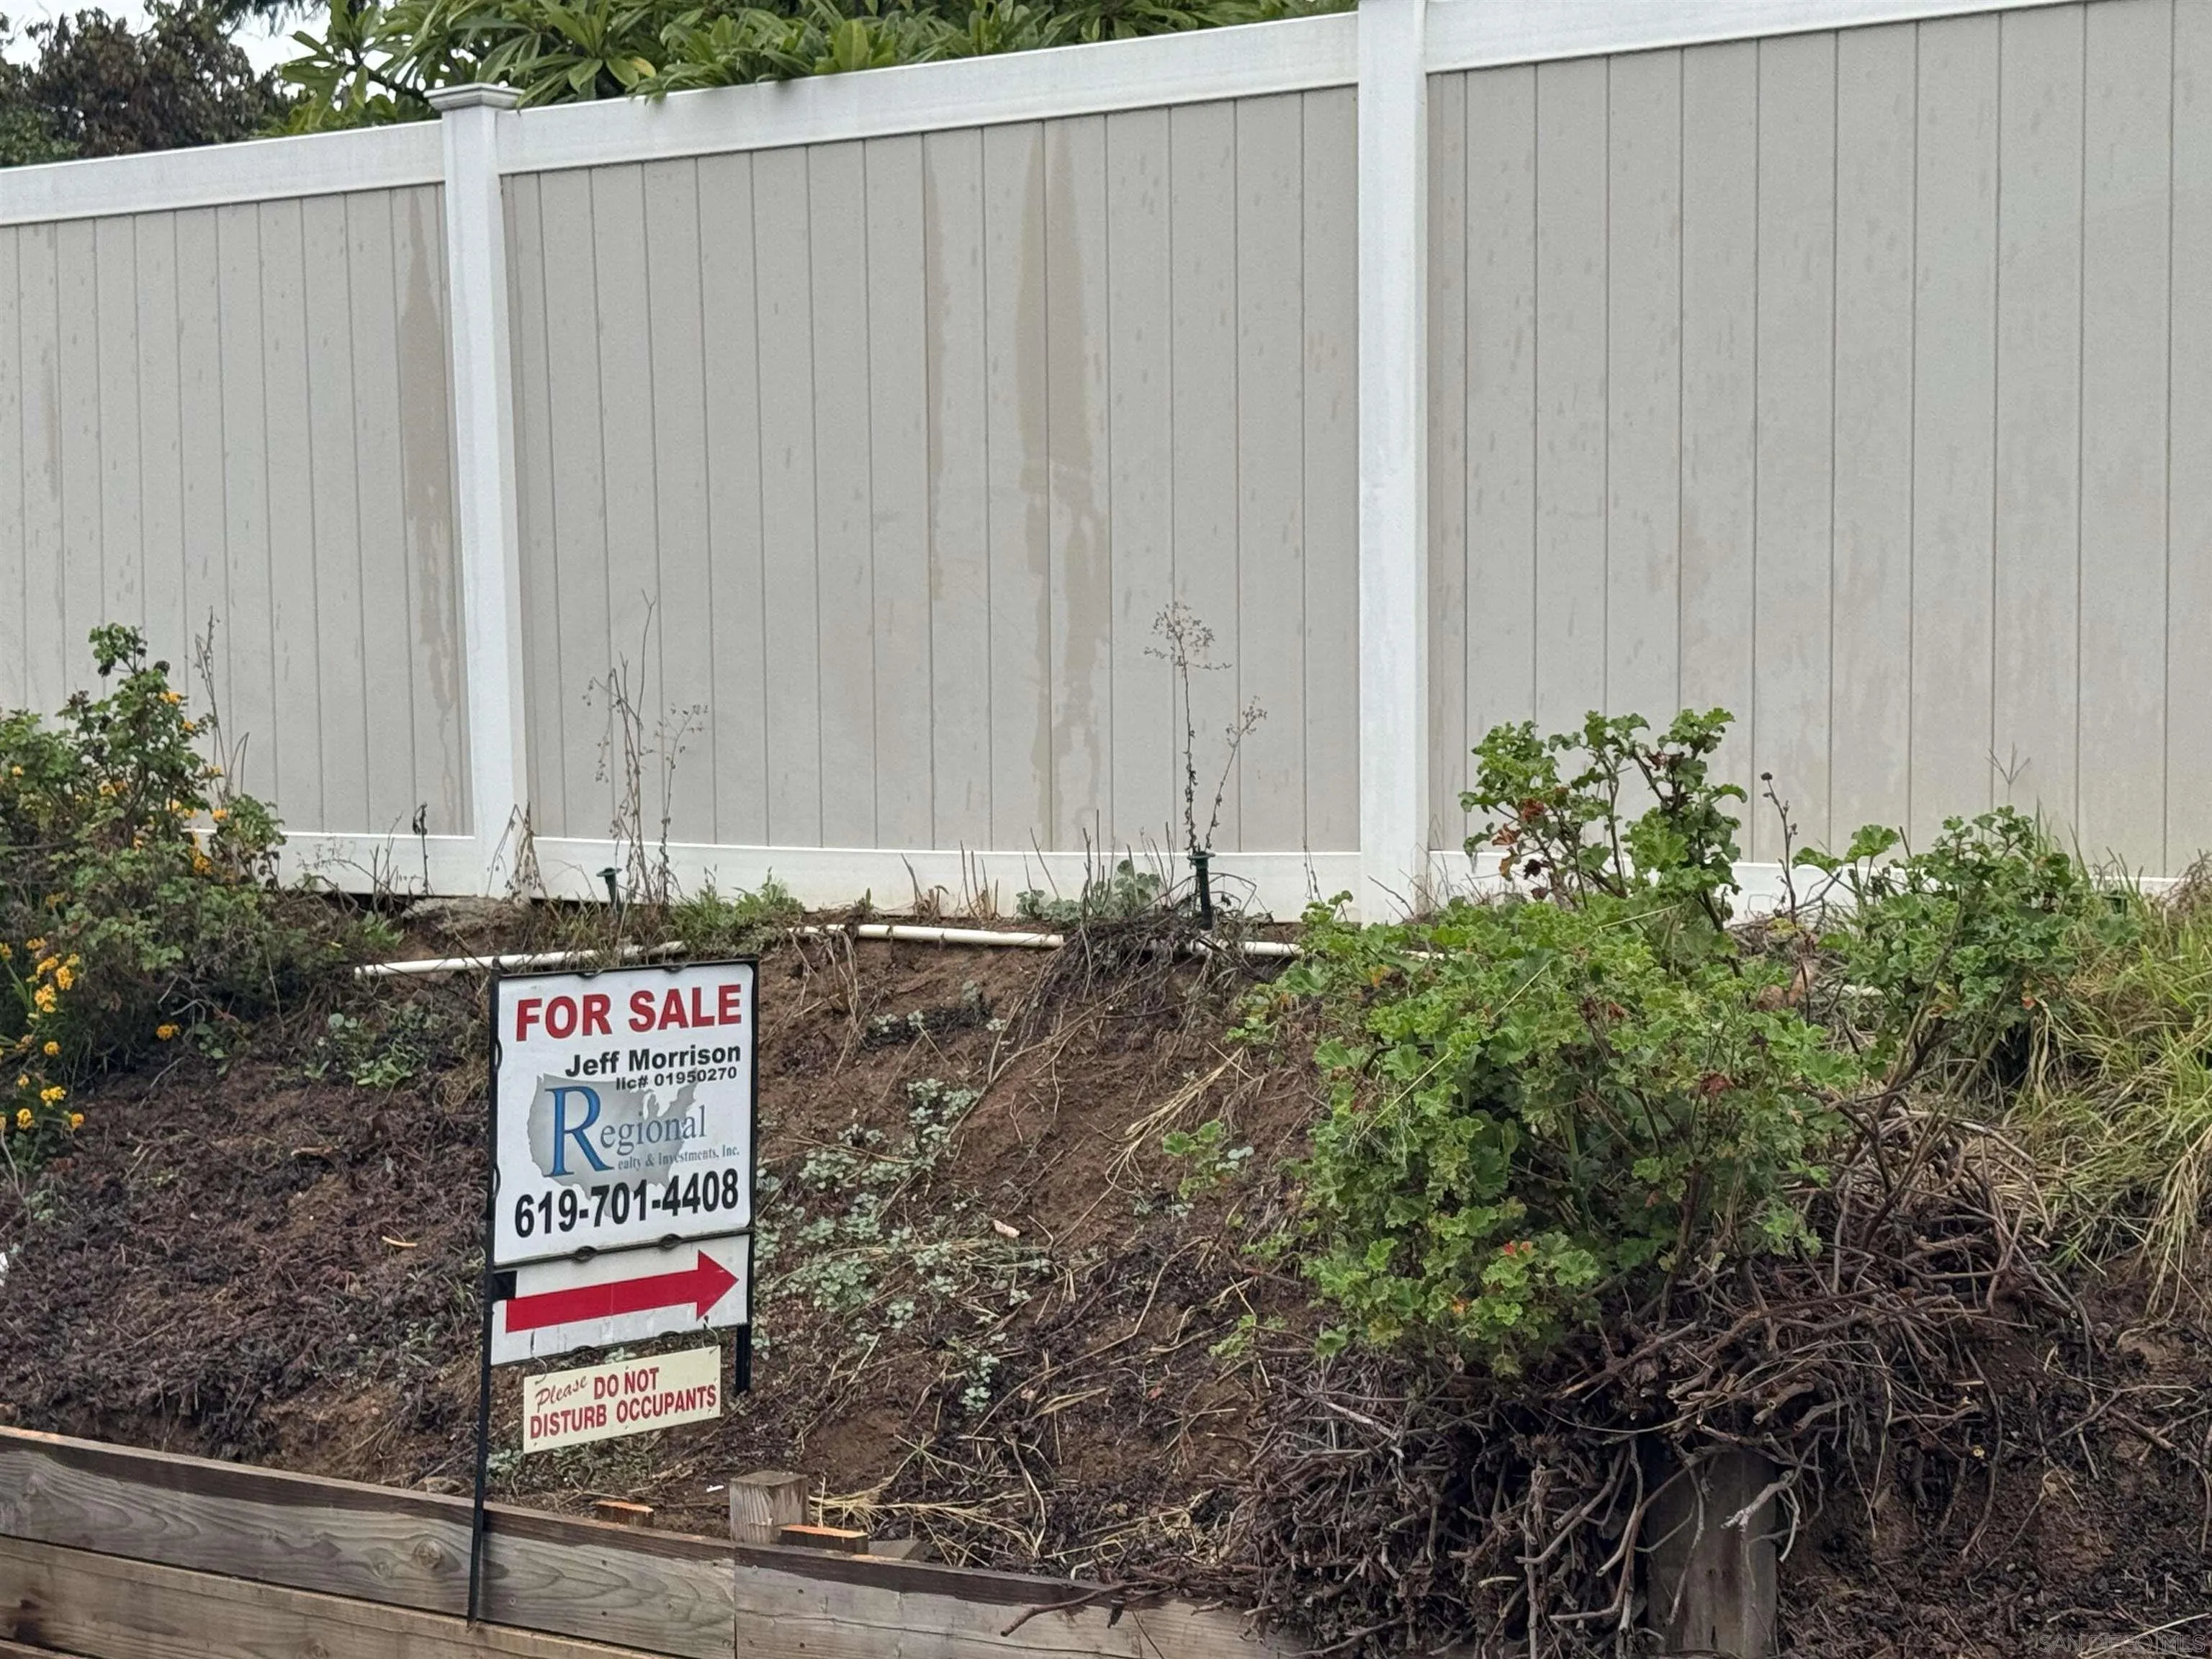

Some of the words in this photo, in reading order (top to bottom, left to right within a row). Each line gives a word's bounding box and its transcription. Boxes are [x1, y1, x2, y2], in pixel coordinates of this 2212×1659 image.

[516, 994, 613, 1042] FOR
[628, 984, 742, 1033] SALE
[565, 1051, 620, 1077] Jeff
[629, 1044, 741, 1071] Morrison
[655, 1066, 737, 1087] 01950270
[544, 1085, 706, 1178] Regional
[645, 1154, 655, 1167] &
[722, 1144, 740, 1157] Inc.
[514, 1168, 739, 1238] 619-701-4408
[530, 1404, 607, 1439] DISTURB
[616, 1385, 716, 1424] OCCUPANTS
[535, 1375, 588, 1413] Please
[593, 1374, 619, 1400] DO
[624, 1367, 660, 1395] NOT
